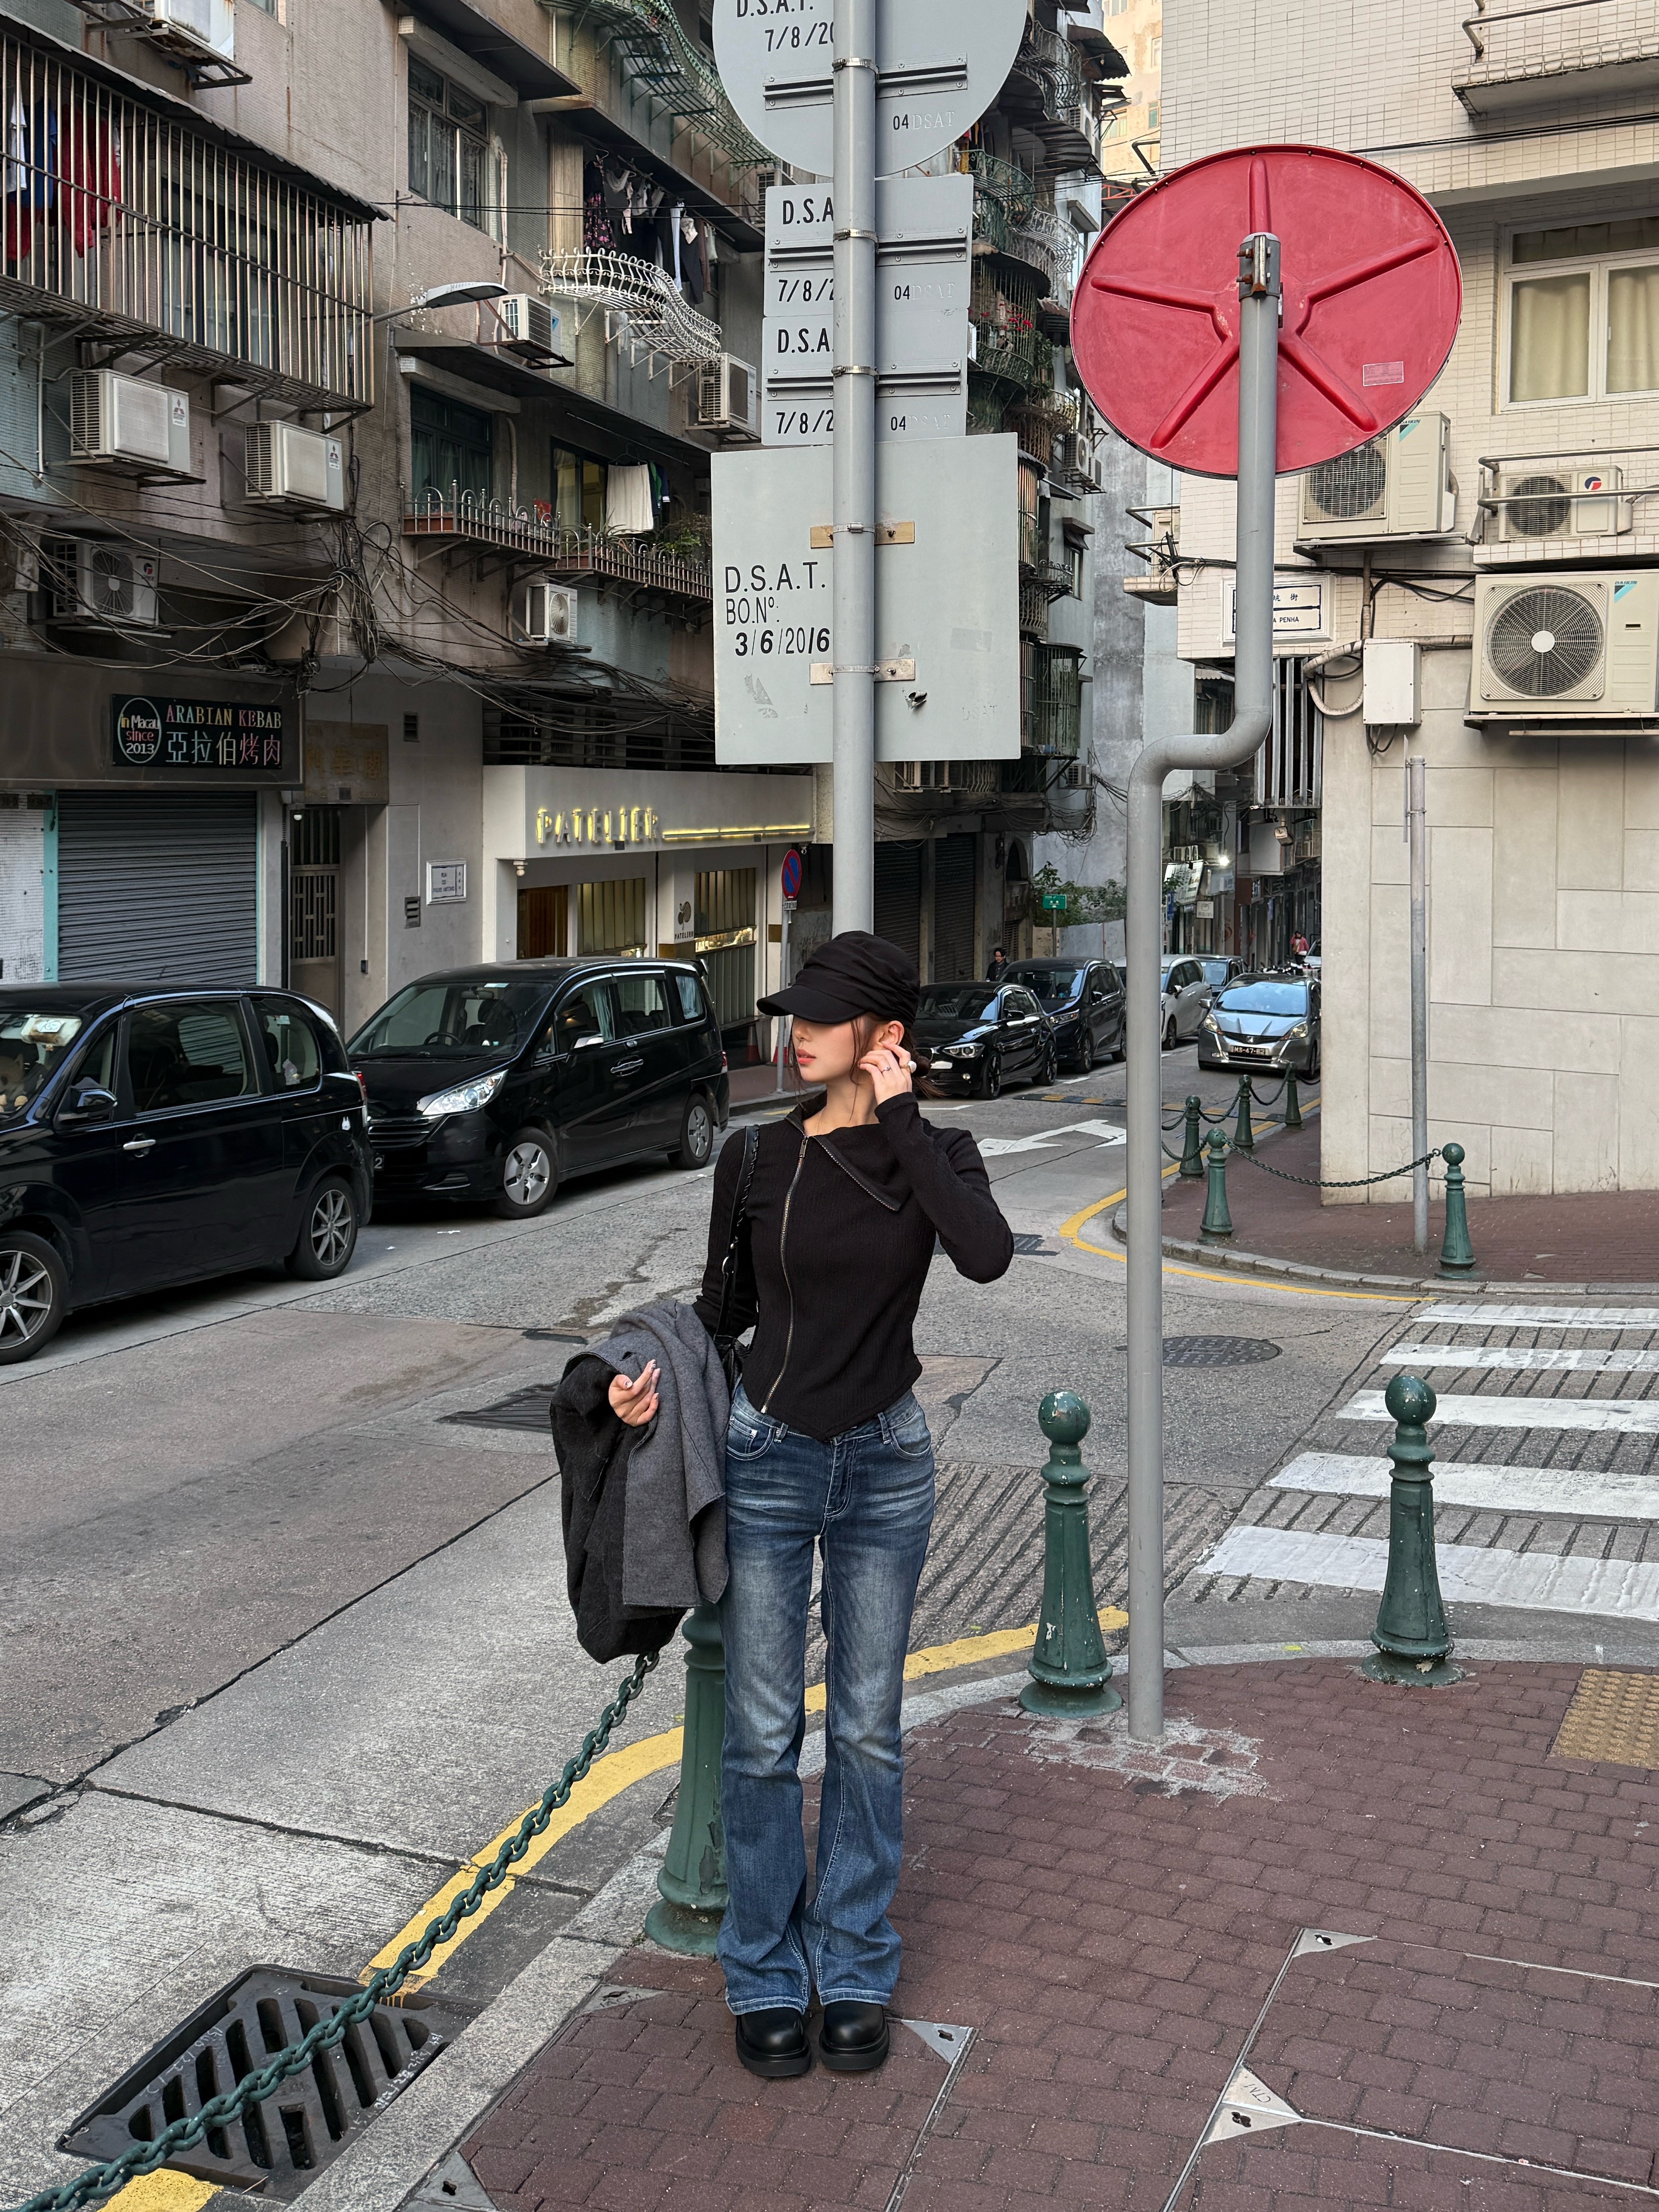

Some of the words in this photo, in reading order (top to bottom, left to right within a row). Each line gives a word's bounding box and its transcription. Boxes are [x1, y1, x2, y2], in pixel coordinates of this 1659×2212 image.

[893, 114, 909, 130] 04
[912, 111, 955, 130] DSAT
[894, 285, 910, 300] 04
[890, 416, 906, 431] 04
[725, 562, 826, 593] D.S.A.T.
[121, 714, 130, 728] in
[131, 715, 160, 730] Macau
[165, 705, 232, 726] ARABIAN
[238, 709, 281, 728] KEBAB
[126, 727, 154, 741] since
[126, 743, 155, 754] 2013
[166, 730, 280, 766] 亞拉伯烤肉
[537, 808, 659, 844] PATELIER
[674, 931, 694, 940] PATELIER
